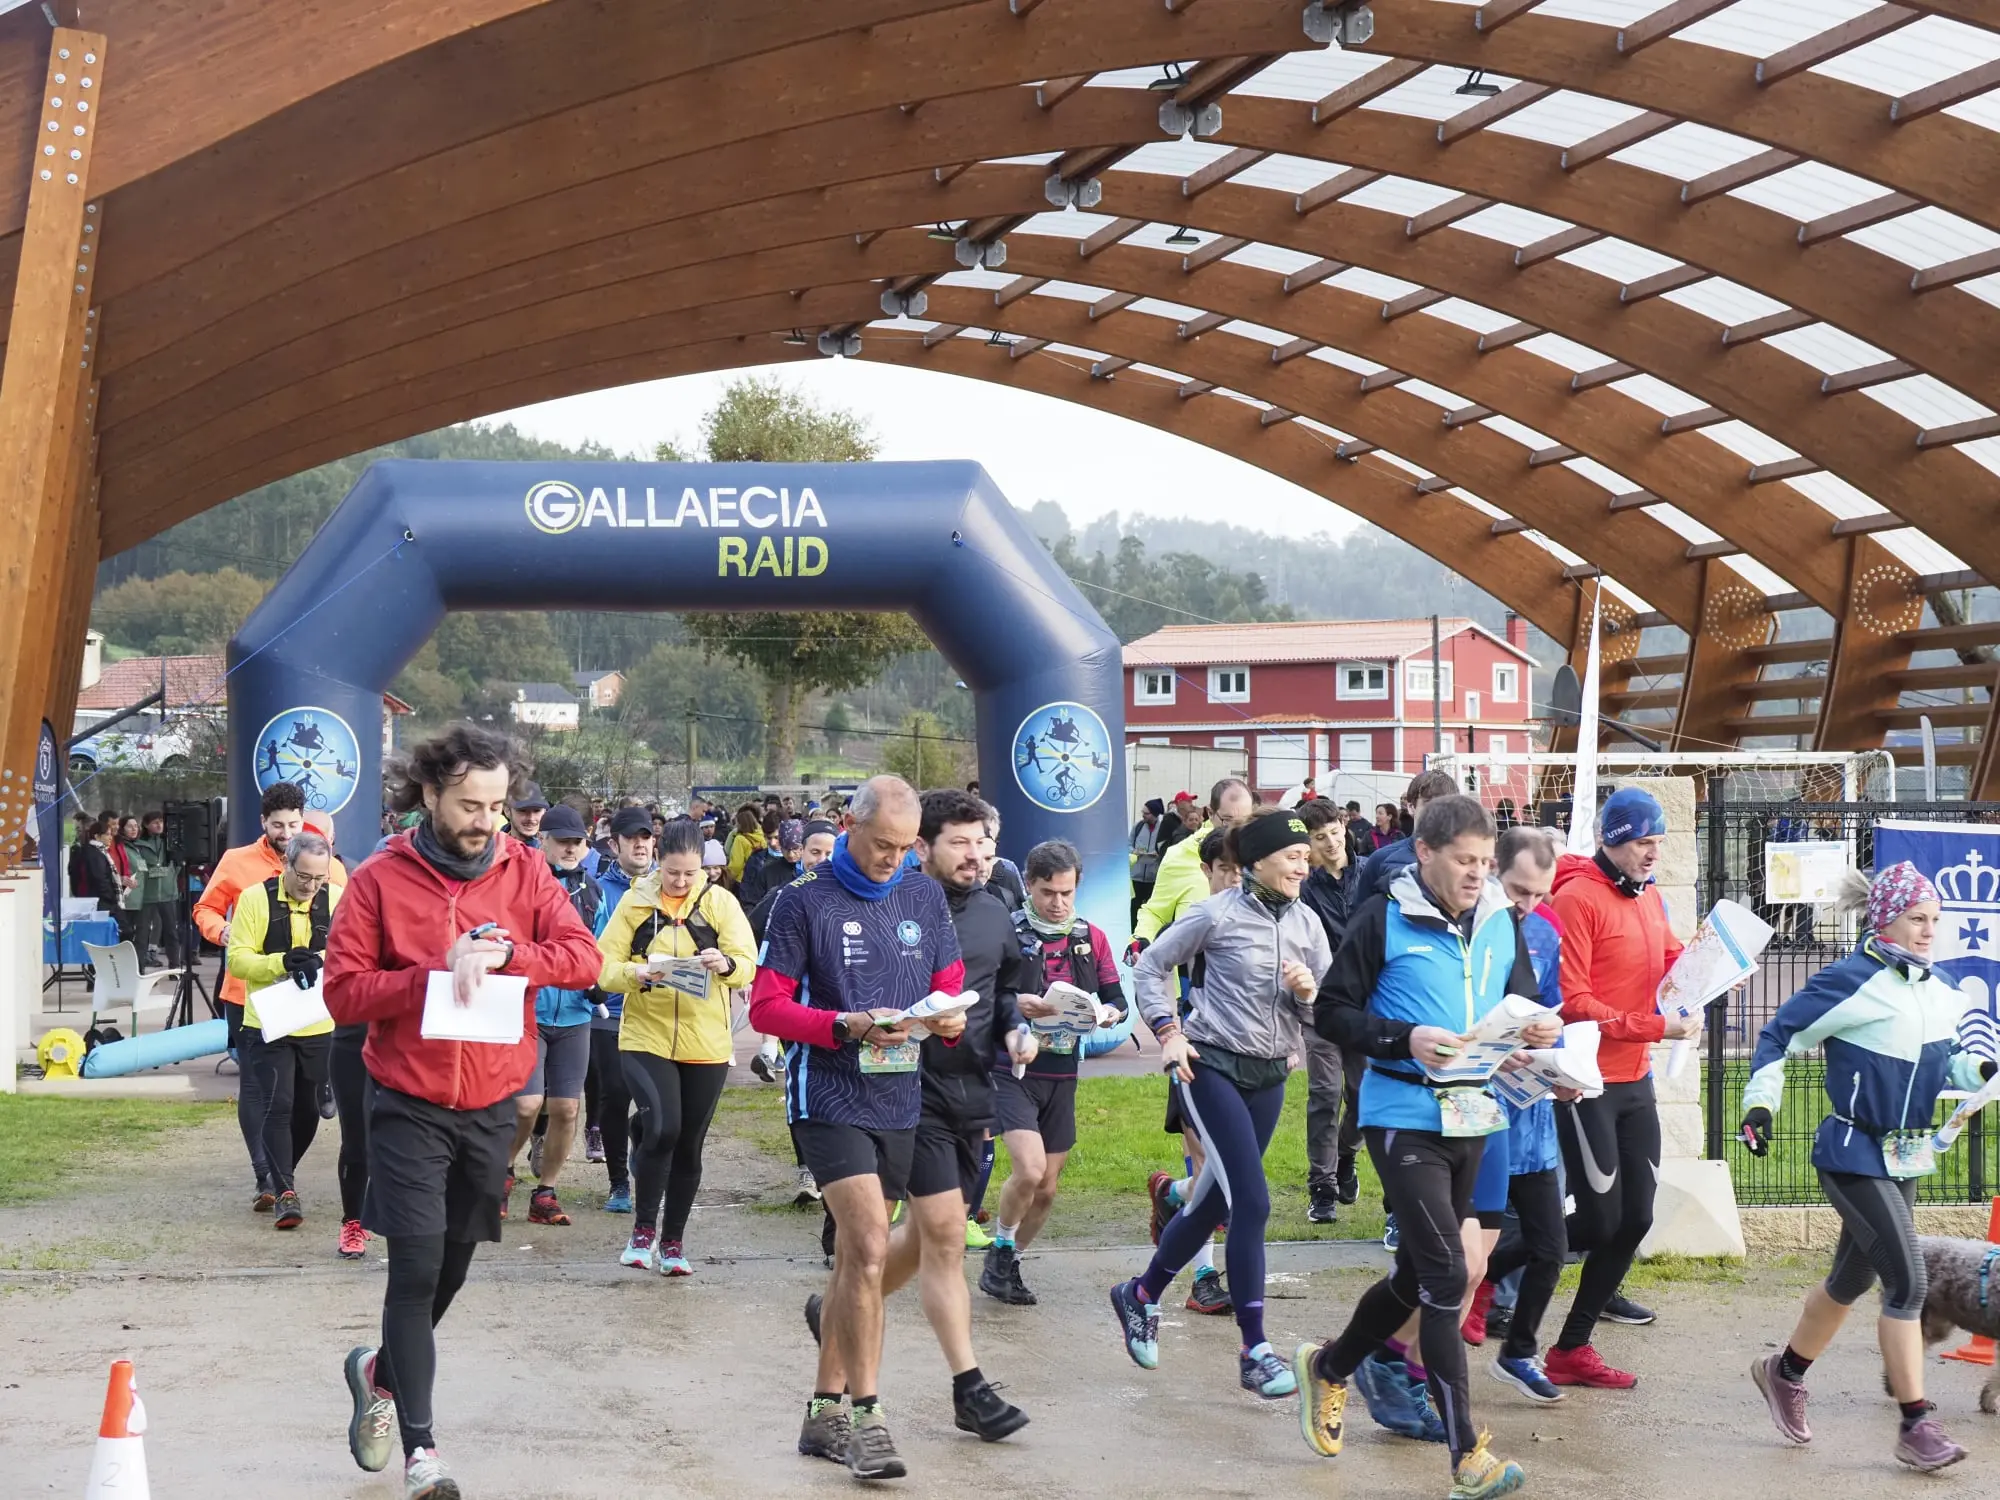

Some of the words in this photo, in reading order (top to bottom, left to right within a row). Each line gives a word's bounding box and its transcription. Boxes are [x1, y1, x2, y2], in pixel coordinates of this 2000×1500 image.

[533, 485, 828, 528] GALLAECIA
[718, 536, 829, 577] RAID
[304, 713, 313, 721] N
[1060, 708, 1068, 717] N
[1607, 823, 1632, 839] UTMB
[101, 1462, 122, 1488] 2
